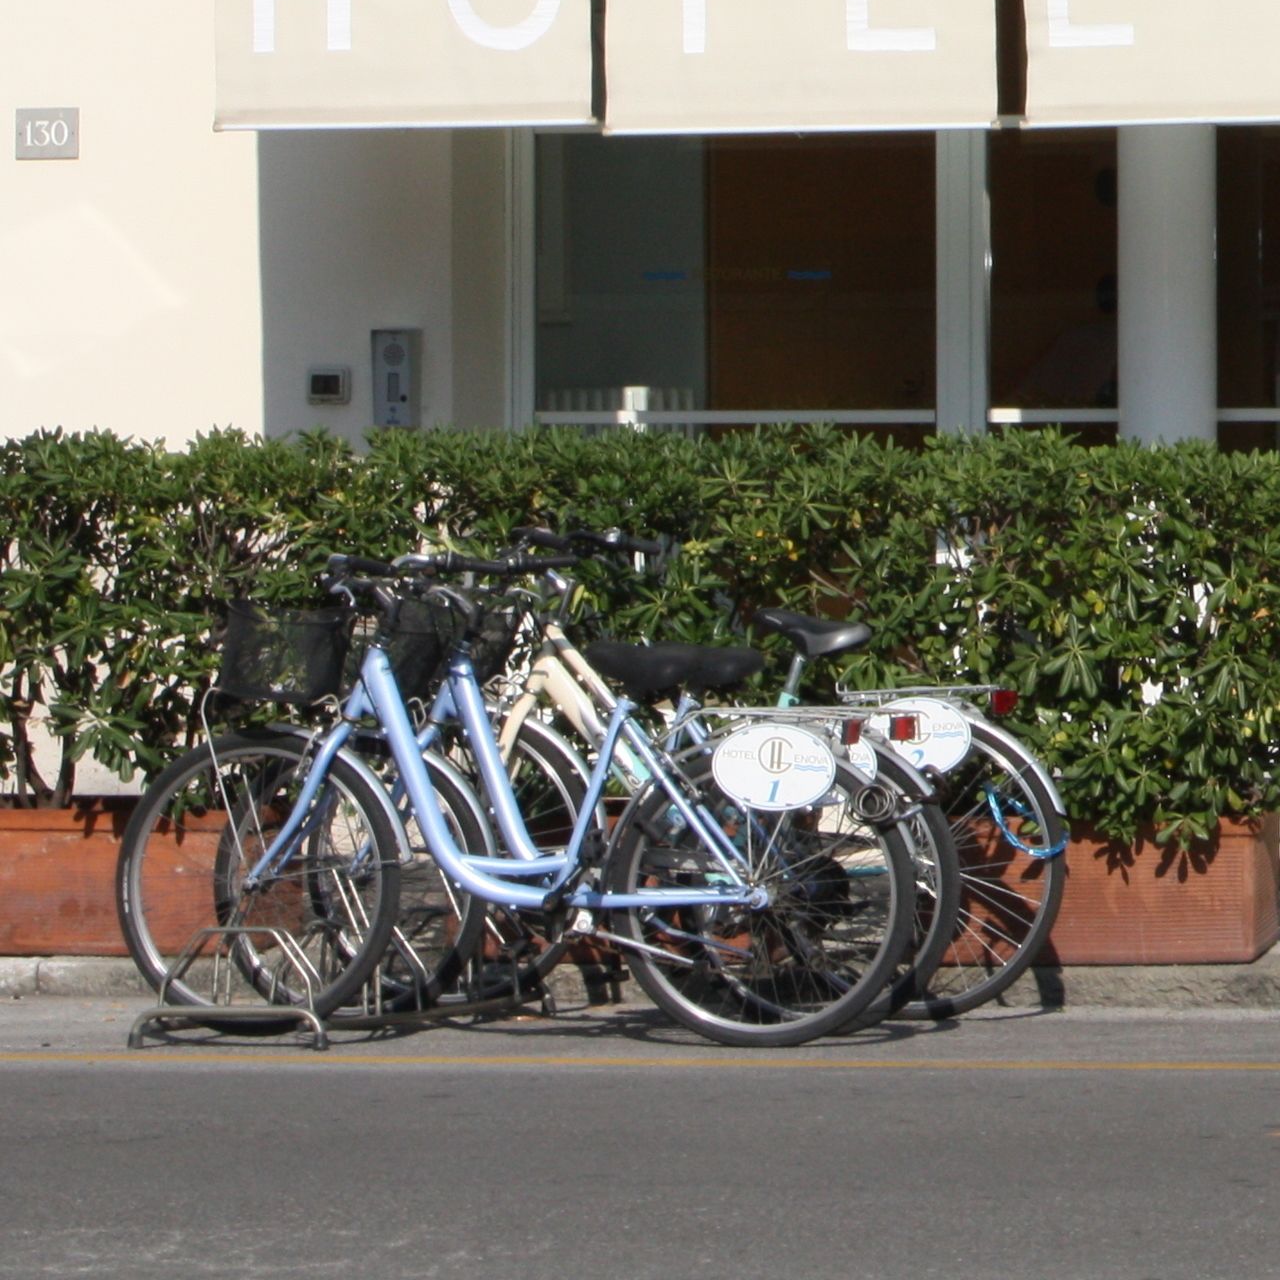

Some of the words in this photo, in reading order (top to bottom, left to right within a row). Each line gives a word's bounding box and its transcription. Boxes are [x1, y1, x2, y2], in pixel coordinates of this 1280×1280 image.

[24, 119, 69, 147] 130
[722, 748, 757, 761] HOTEL
[767, 779, 781, 803] 1
